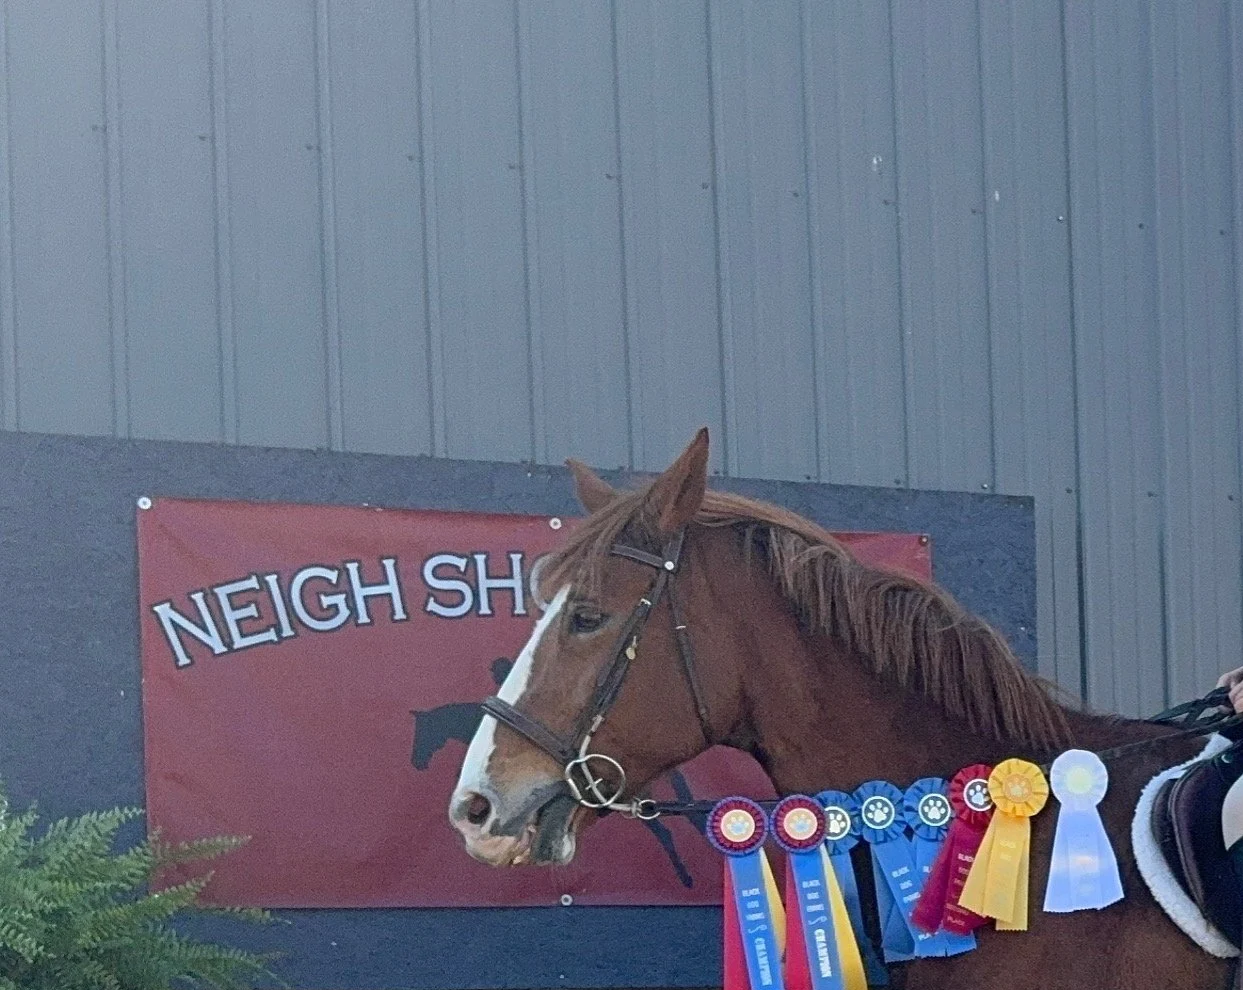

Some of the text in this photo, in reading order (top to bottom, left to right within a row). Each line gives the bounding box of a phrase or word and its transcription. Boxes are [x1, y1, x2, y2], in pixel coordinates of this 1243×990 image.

[153, 558, 407, 667] NEIGH
[754, 936, 773, 986] CHAMPION
[814, 928, 832, 978] CHAMPION
